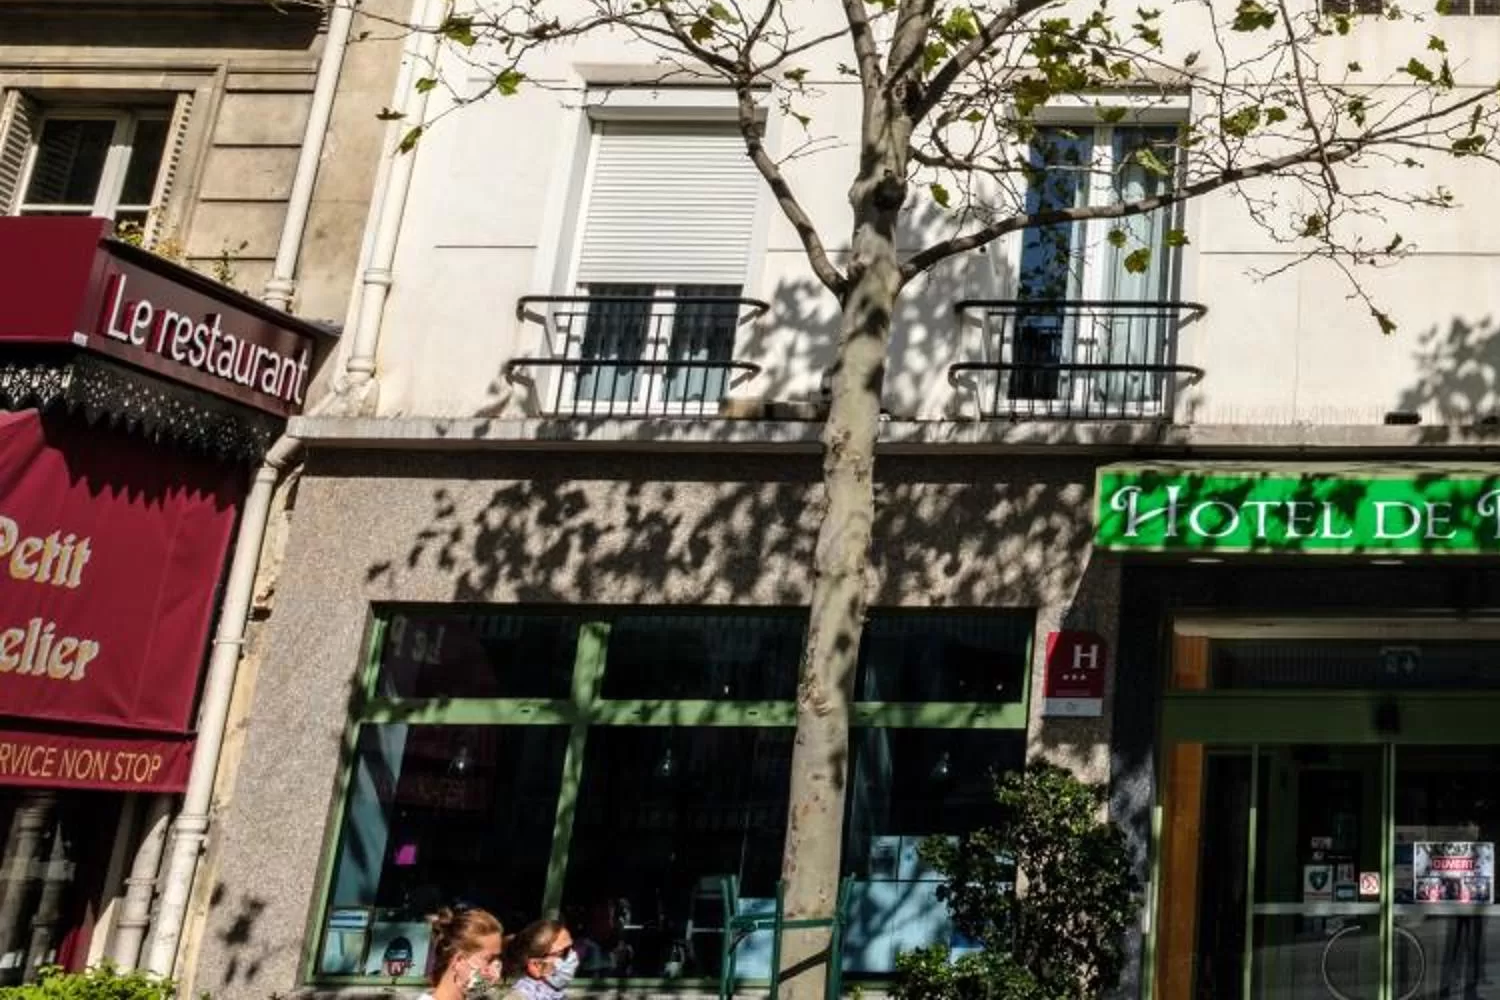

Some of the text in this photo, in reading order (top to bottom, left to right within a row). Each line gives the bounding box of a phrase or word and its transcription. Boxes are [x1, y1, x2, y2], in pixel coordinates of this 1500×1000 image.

[107, 273, 308, 405] Le restaurant
[1110, 485, 1353, 539] HOTEL
[1372, 501, 1457, 539] DE
[1072, 644, 1099, 669] H
[57, 749, 111, 780] NON
[111, 751, 162, 783] STOP
